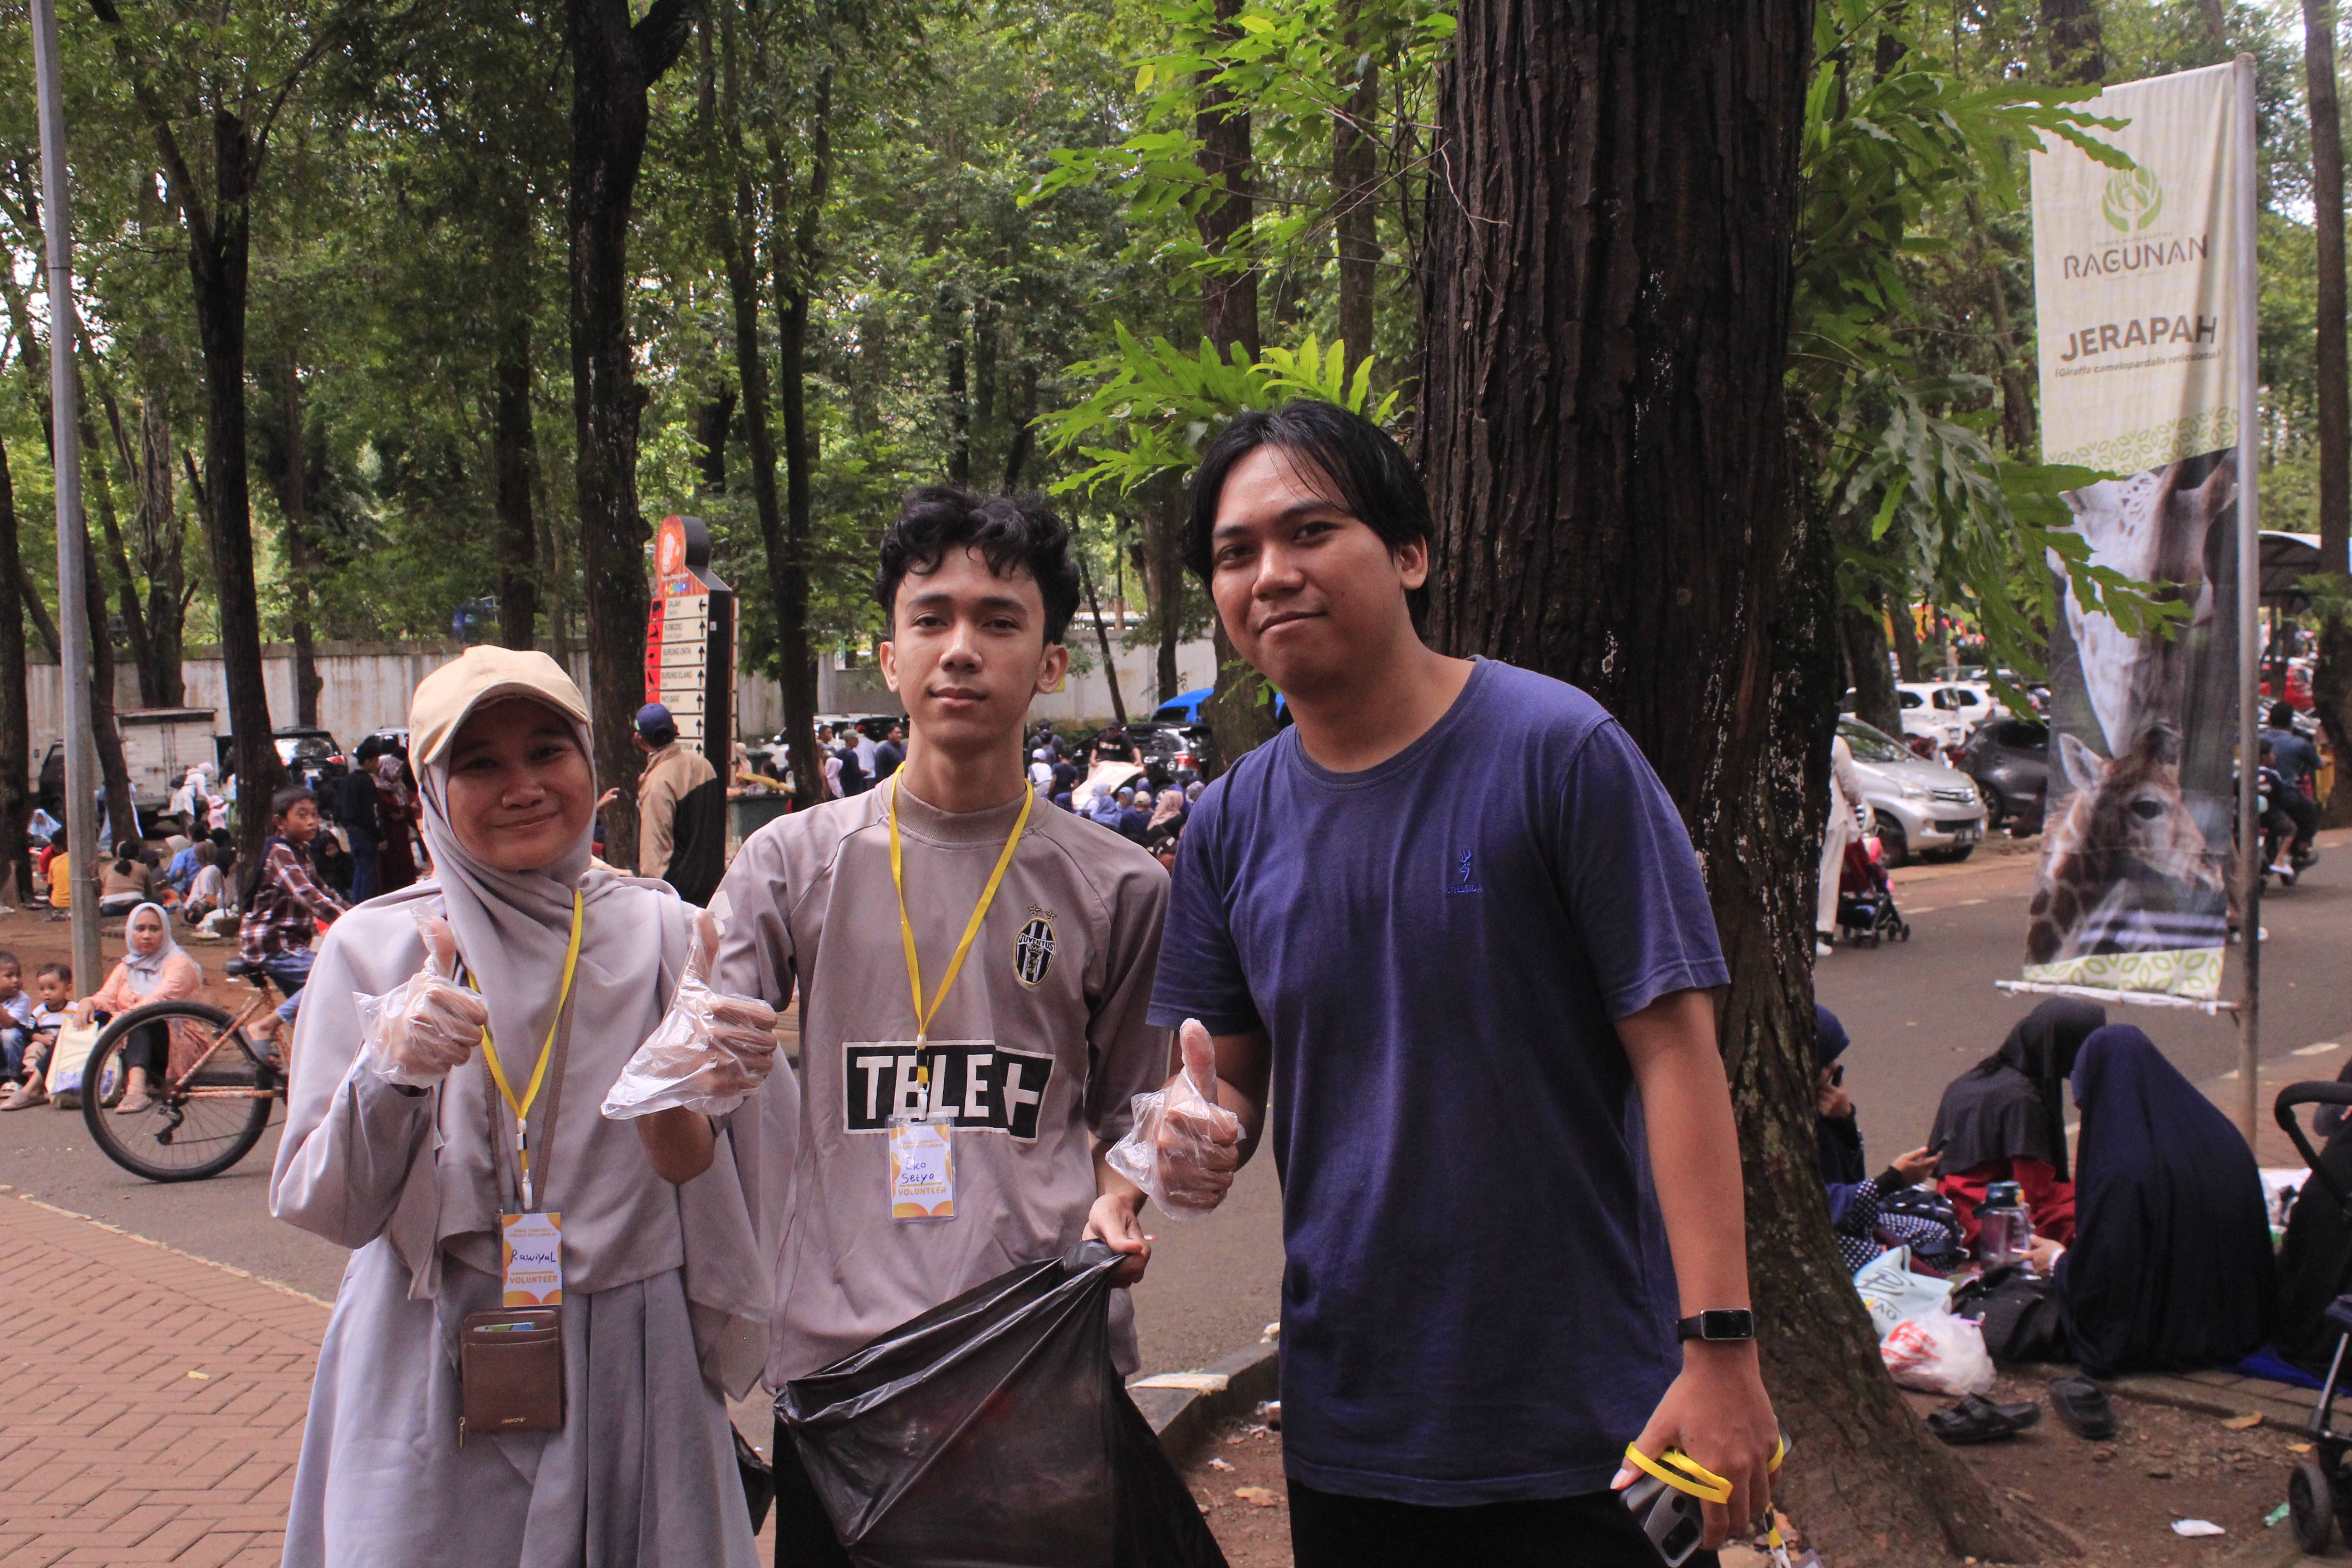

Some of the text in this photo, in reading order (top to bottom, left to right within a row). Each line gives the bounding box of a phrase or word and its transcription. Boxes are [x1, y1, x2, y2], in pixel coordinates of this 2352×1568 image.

[2064, 234, 2208, 279] RAGUNAN
[2060, 314, 2218, 362] JERAPAH
[2054, 366, 2092, 378] (Giraffa
[2093, 357, 2166, 373] camelopardalis
[665, 623, 682, 631] KOMODO
[1019, 935, 1054, 951] JUVENTUS
[906, 1156, 926, 1171] Eko
[902, 1173, 935, 1185] Setyo
[898, 1187, 946, 1196] VOLUNTEER
[510, 1275, 558, 1284] VOLUNTEER
